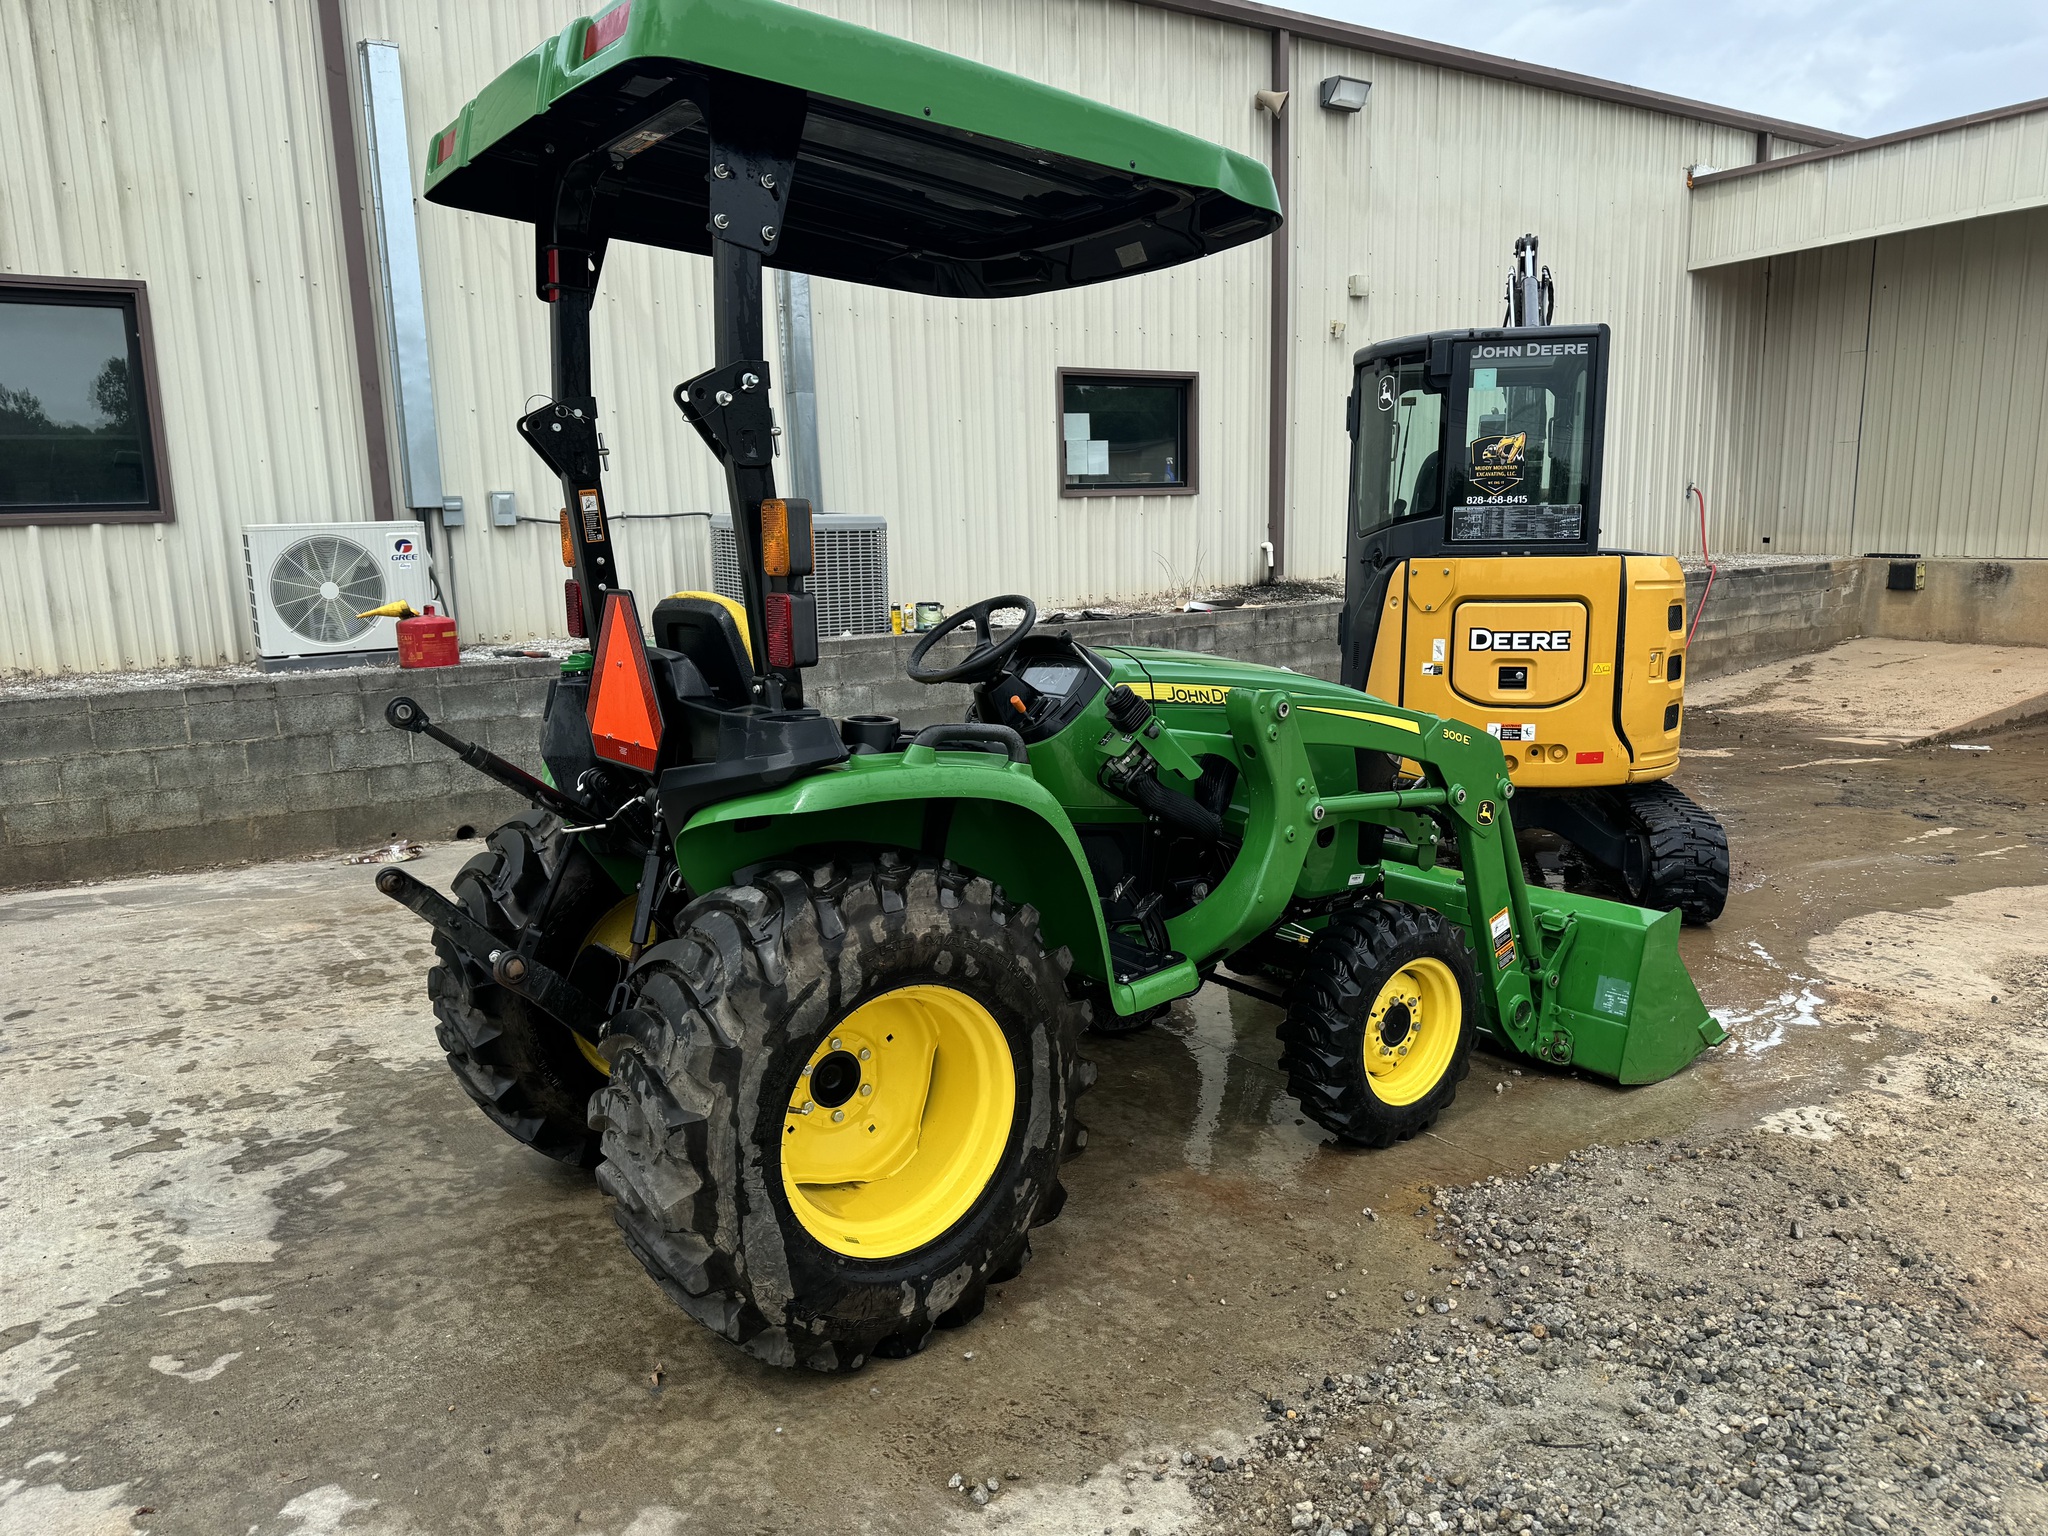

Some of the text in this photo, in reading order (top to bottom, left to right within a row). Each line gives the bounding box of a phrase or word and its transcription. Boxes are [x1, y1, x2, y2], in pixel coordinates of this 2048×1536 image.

[1472, 343, 1589, 359] JOHN DEERE
[1466, 495, 1528, 504] 828-458-8415
[391, 553, 418, 561] GREE
[1469, 627, 1571, 651] DEERE
[1167, 686, 1210, 702] JOHN
